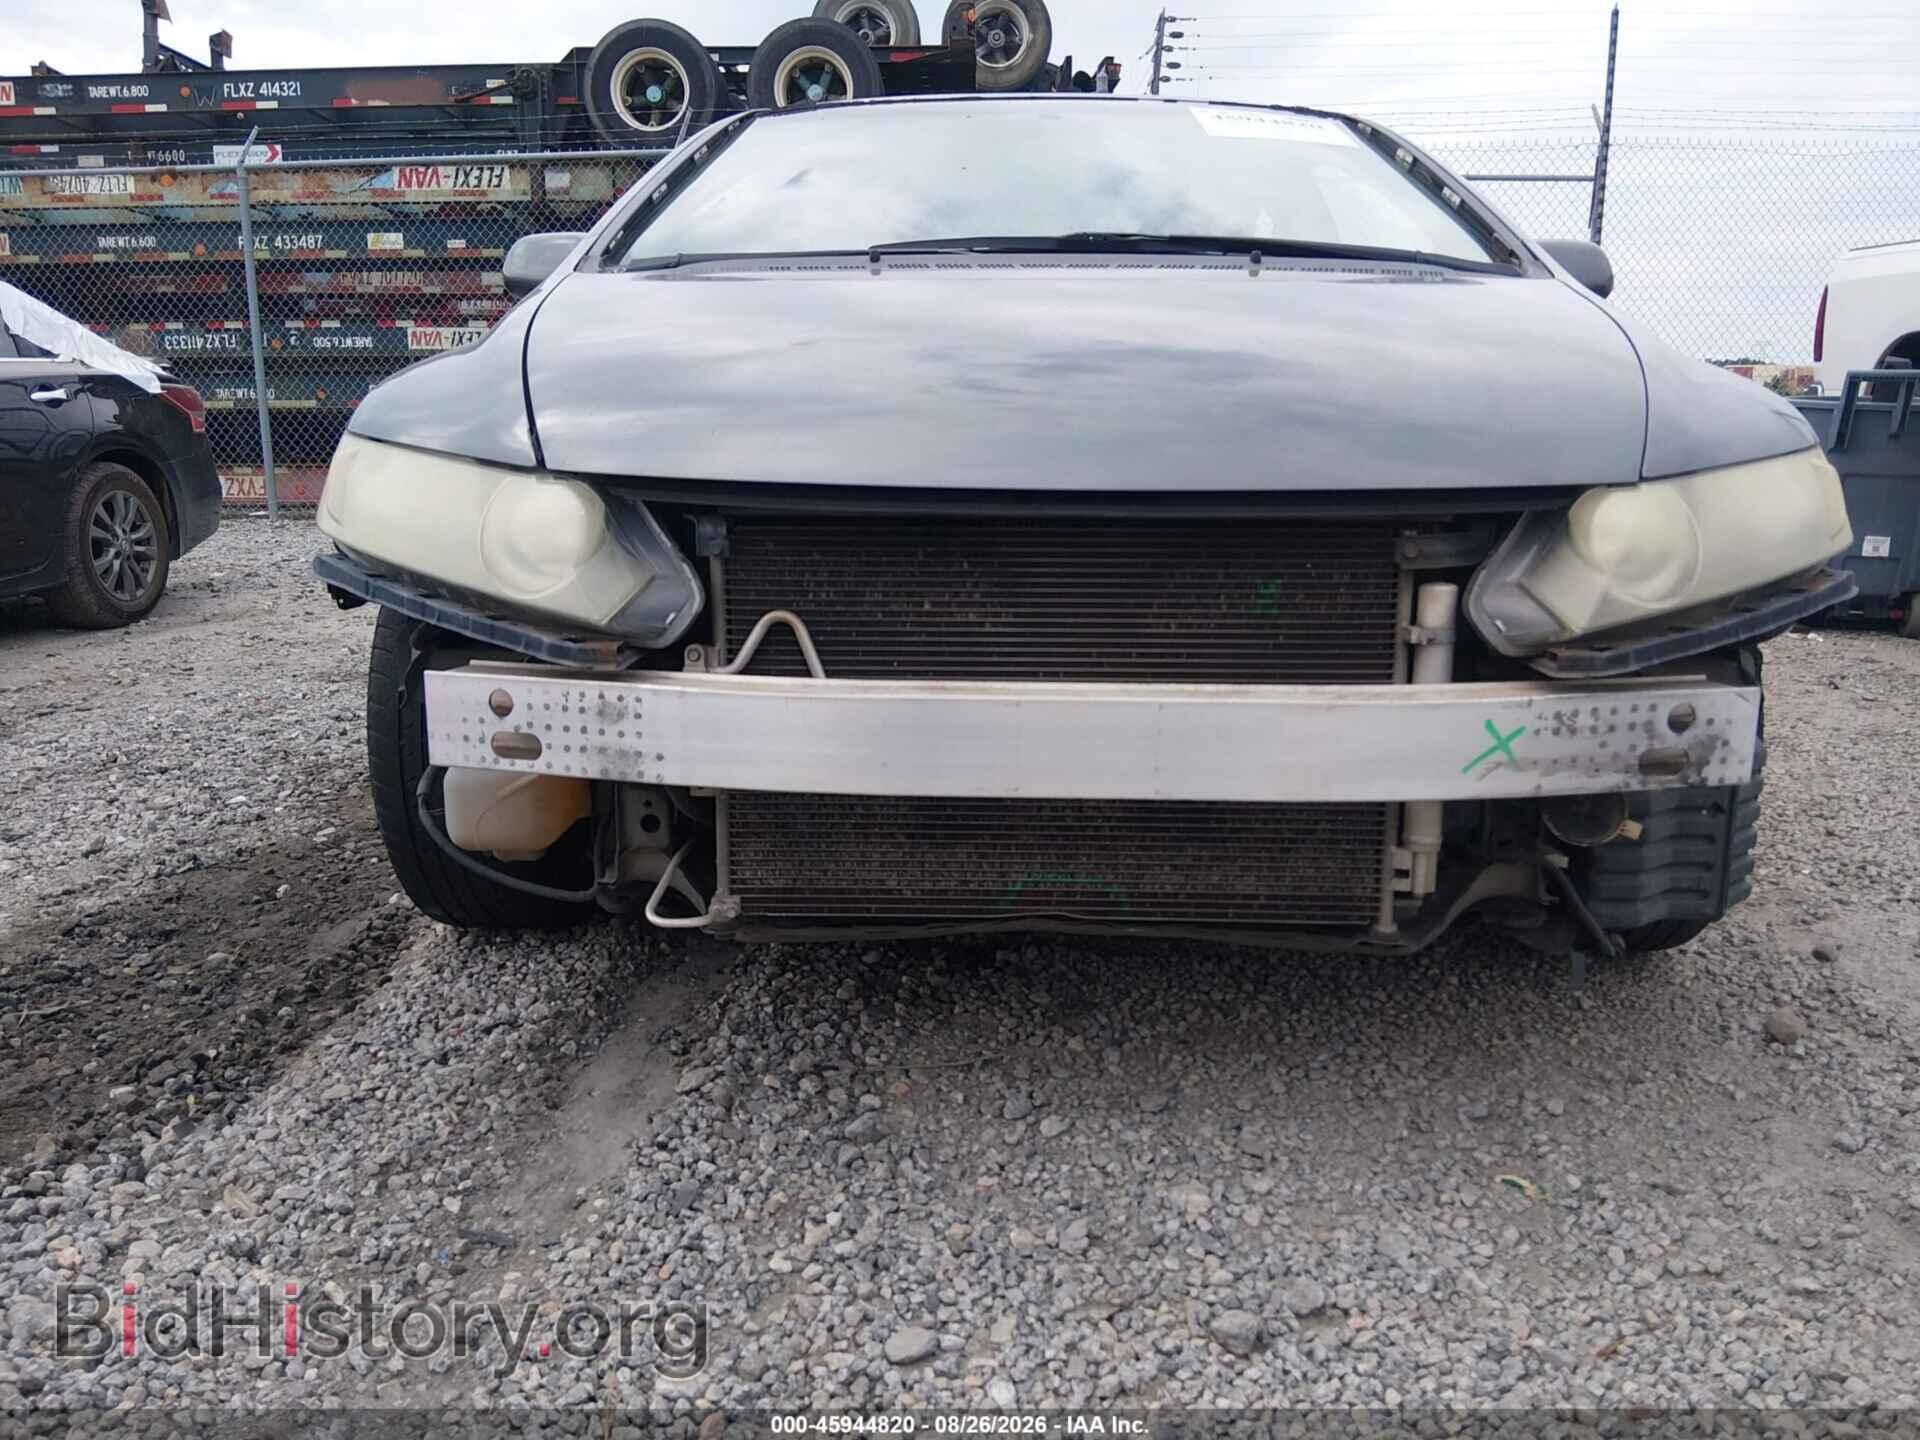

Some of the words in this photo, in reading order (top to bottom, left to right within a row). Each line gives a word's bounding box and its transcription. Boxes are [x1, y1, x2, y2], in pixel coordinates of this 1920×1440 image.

[224, 82, 255, 98] FLXZ
[259, 81, 301, 96] 414321
[397, 166, 504, 188] FLEXI-VAN
[238, 235, 268, 249] FXZ
[275, 235, 322, 249] 433487
[205, 334, 236, 349] FLXZ
